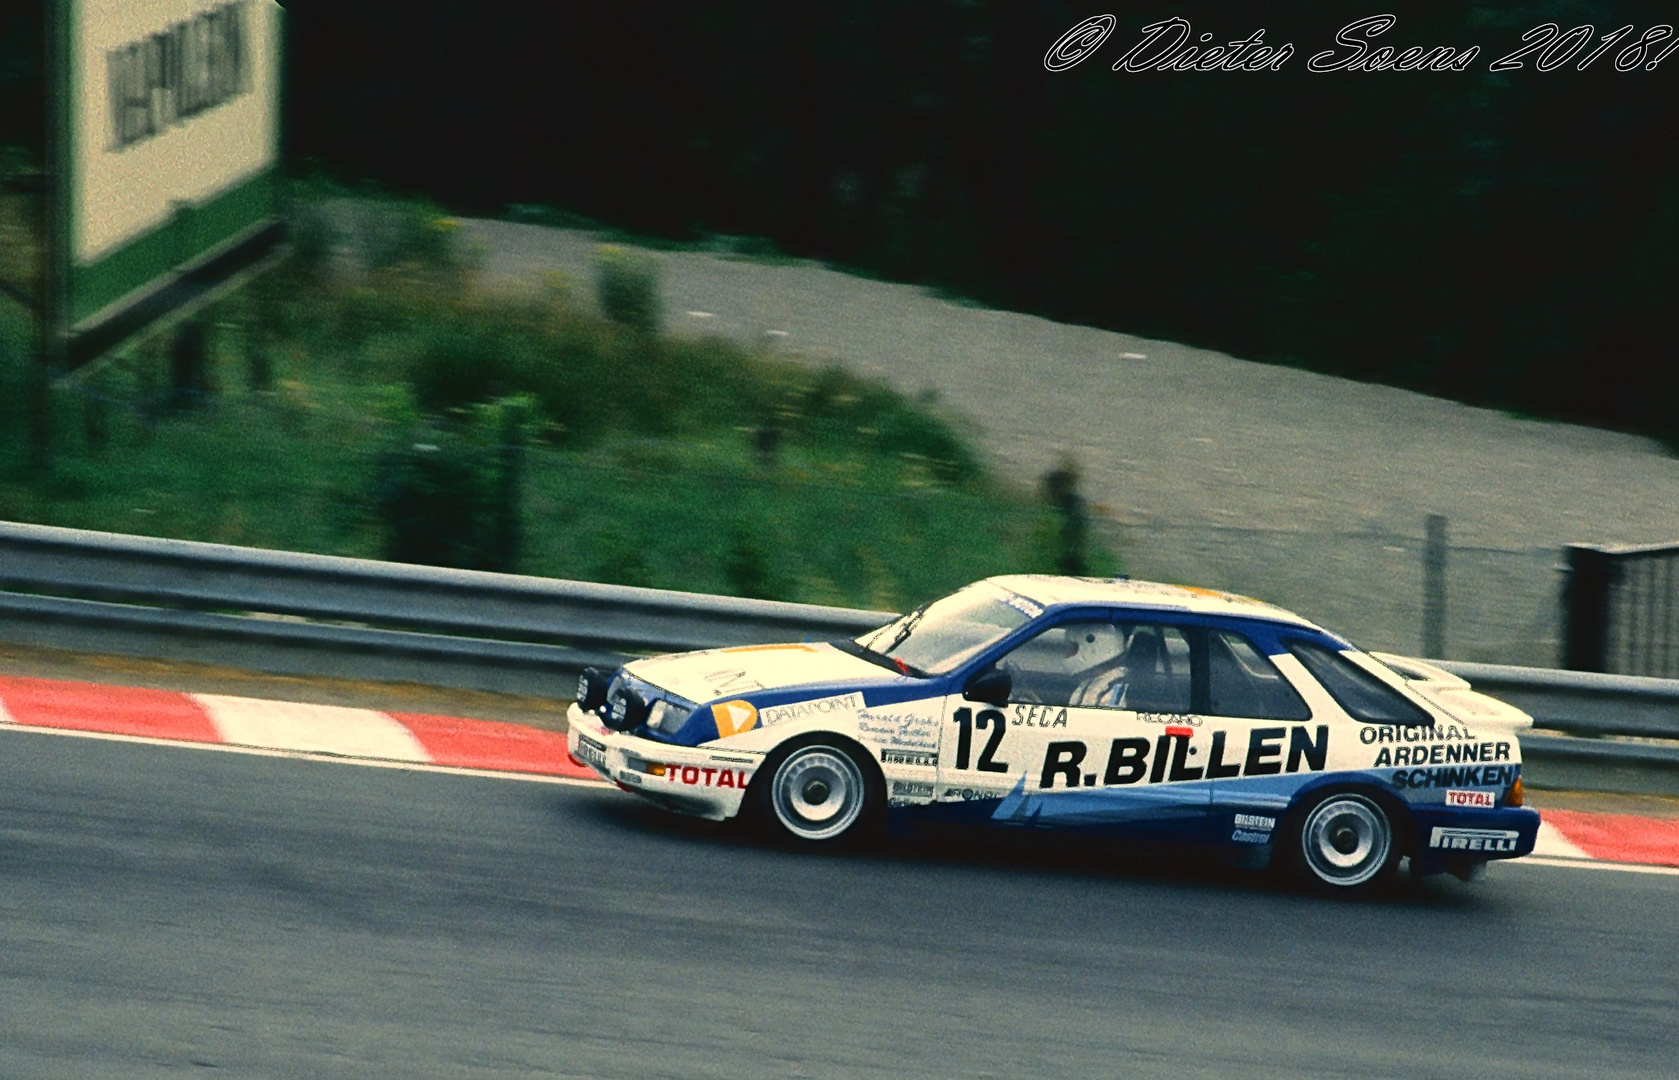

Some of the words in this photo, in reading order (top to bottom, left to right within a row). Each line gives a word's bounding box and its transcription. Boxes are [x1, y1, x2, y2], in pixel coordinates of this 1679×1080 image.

[1012, 705, 1068, 728] SECA
[953, 707, 1009, 773] 12
[1360, 724, 1477, 745] ORIGINAL
[1374, 742, 1510, 767] ARDENNER
[664, 763, 748, 789] TOTAL
[1392, 764, 1513, 790] SCHINKEN
[1448, 791, 1493, 806] TOTAL
[1429, 826, 1519, 851] PIRELLI
